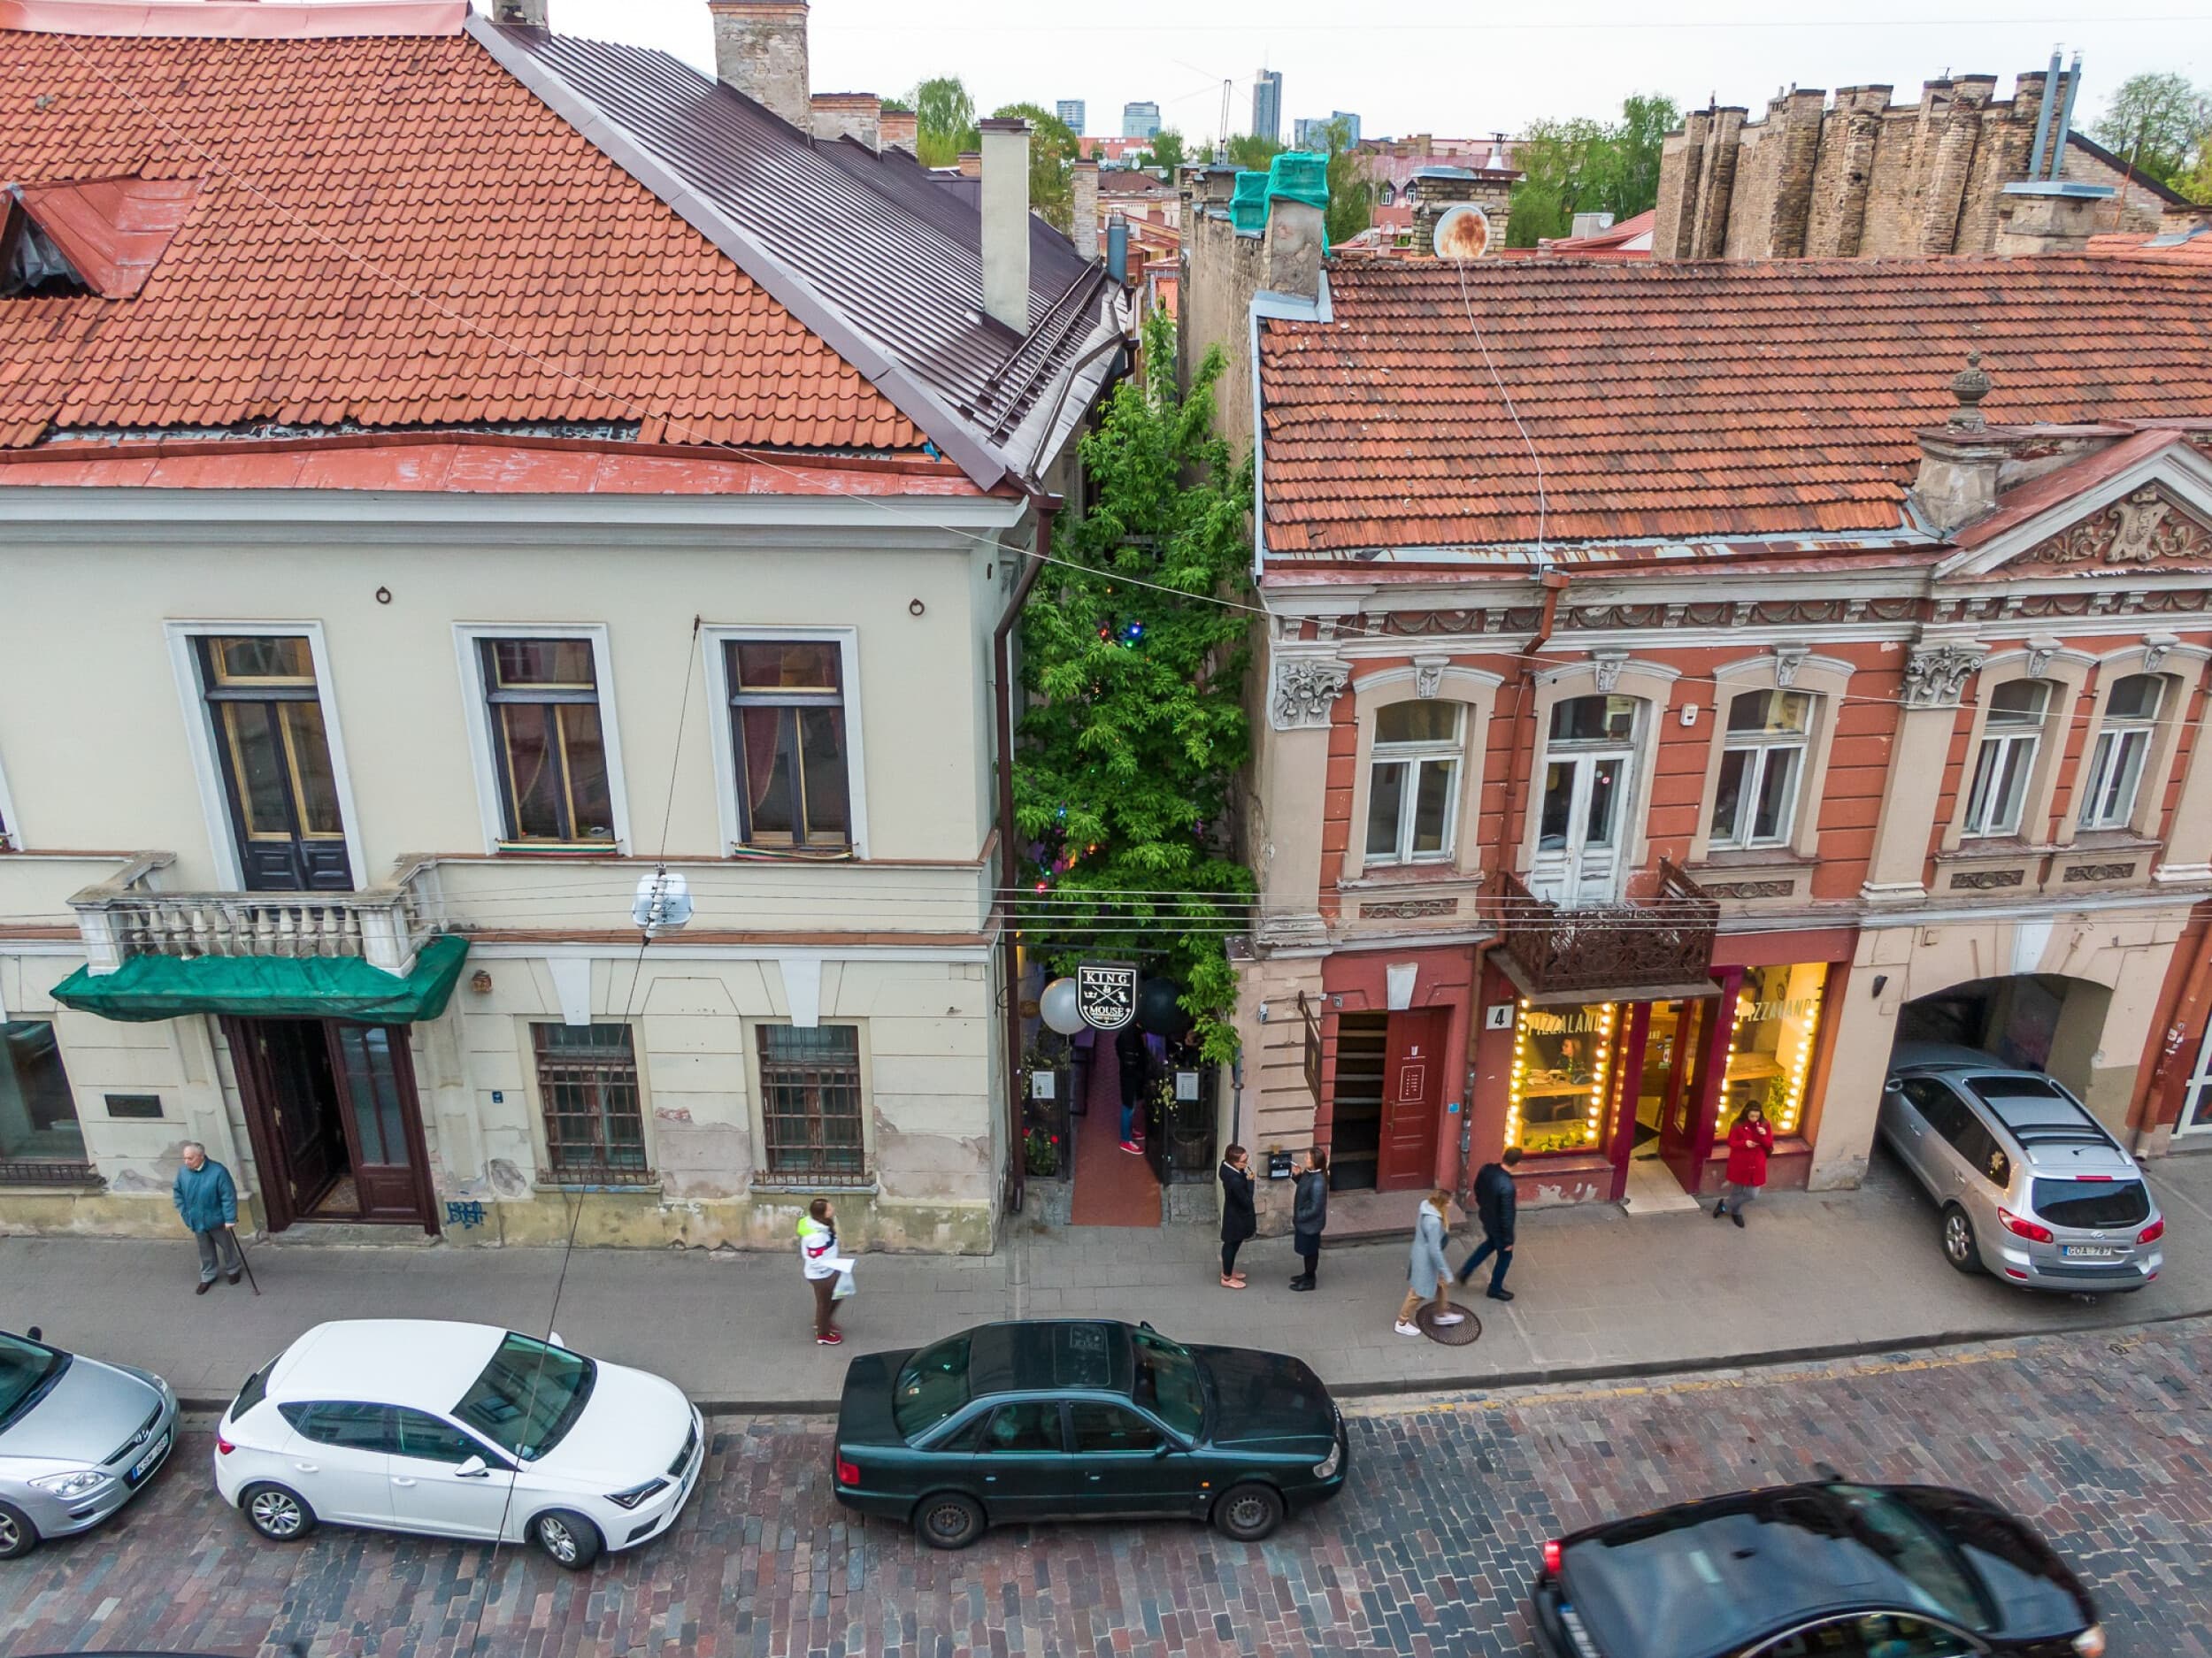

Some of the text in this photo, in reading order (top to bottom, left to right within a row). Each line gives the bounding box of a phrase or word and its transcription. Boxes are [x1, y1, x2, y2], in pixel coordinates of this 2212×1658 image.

[1086, 972, 1127, 984] KING
[1089, 1005, 1124, 1017] MOUSE
[1494, 1009, 1504, 1025] 4
[1527, 1011, 1603, 1037] PIZZALAND
